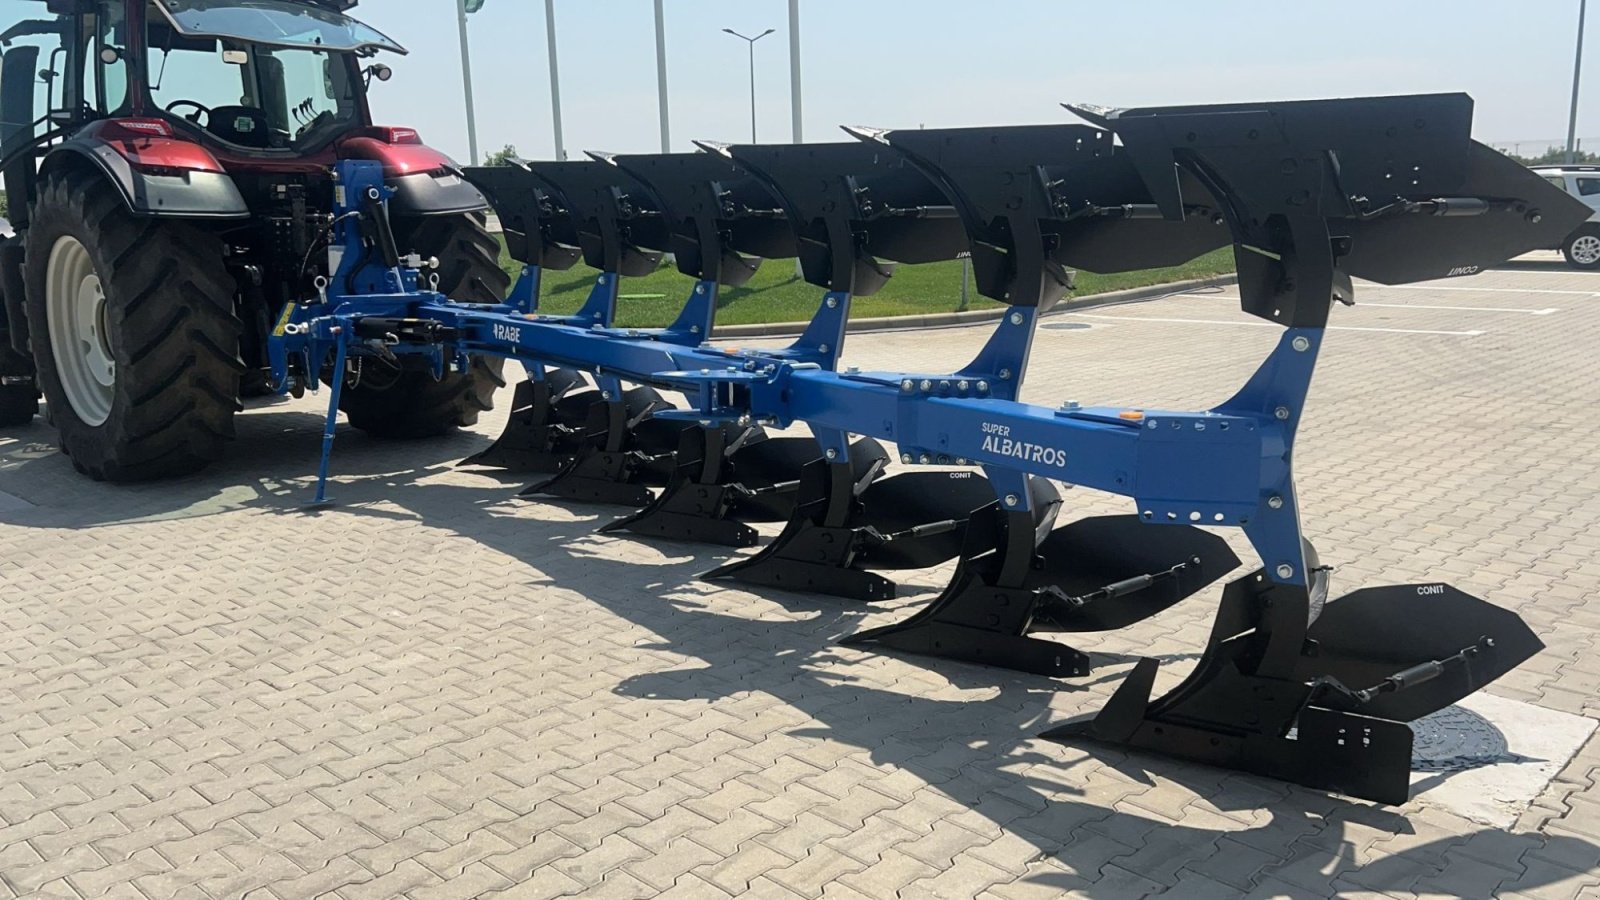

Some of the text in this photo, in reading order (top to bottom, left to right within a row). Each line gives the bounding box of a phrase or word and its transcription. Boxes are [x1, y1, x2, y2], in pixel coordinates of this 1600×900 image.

[1446, 265, 1478, 276] CONIT
[498, 324, 520, 343] RABE
[981, 422, 1010, 436] SUPER
[981, 436, 1066, 467] ALBATROS
[1417, 585, 1444, 595] CONIT
